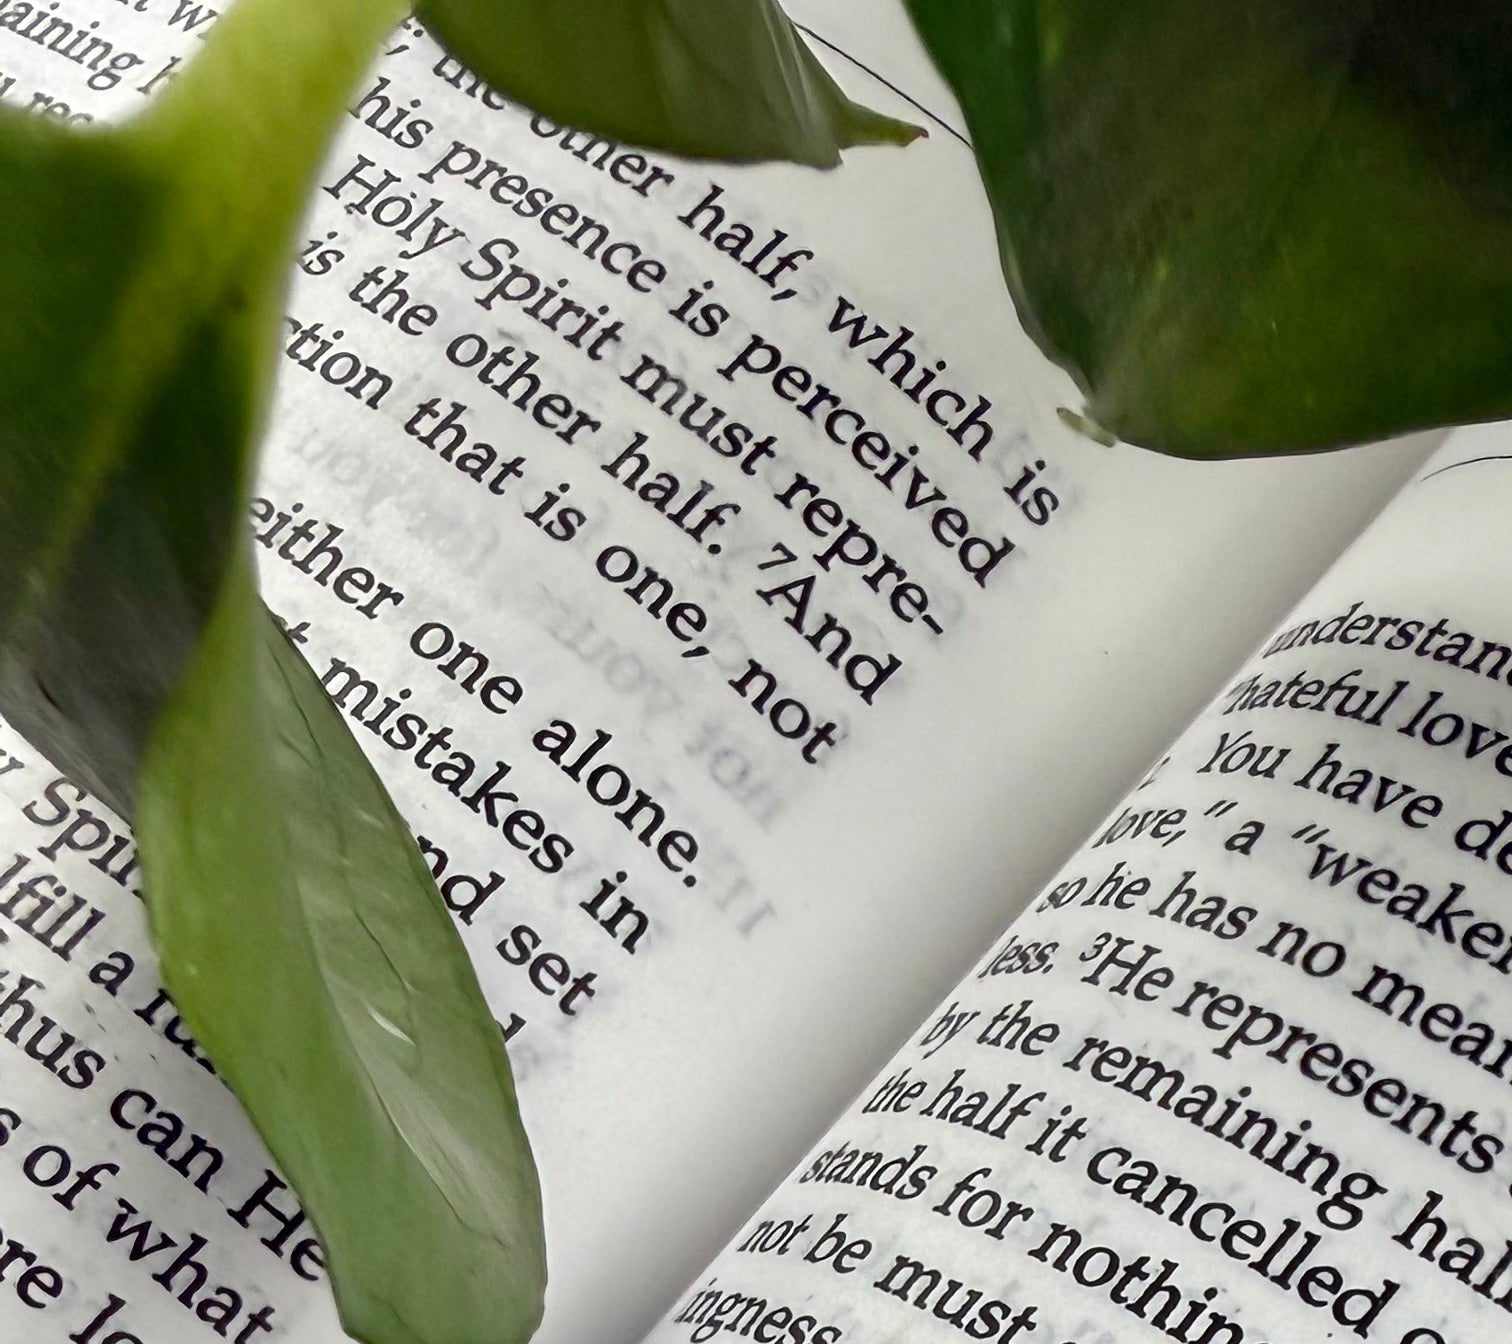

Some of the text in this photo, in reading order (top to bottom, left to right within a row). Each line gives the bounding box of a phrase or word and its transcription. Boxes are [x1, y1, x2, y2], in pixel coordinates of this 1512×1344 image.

[323, 155, 943, 635] Holy Spirit must repre-
[349, 266, 741, 554] the other half.
[418, 141, 1015, 588] presence is perceived
[678, 185, 1059, 525] half, which is
[404, 398, 836, 764] that is one, not
[322, 655, 648, 954] mistakes in
[410, 623, 698, 887] one alone.
[1197, 731, 1291, 778] You
[1294, 744, 1443, 828] have
[88, 952, 134, 997] a
[496, 925, 597, 1016] set
[1149, 871, 1258, 939] has
[1257, 922, 1346, 977] no
[110, 1089, 223, 1194] can
[1063, 1038, 1388, 1230] remaining
[1172, 982, 1504, 1173] represents
[23, 1145, 120, 1211] of
[803, 1214, 872, 1273] be
[920, 1069, 1046, 1139] half
[1087, 1147, 1400, 1339] cancelled
[932, 1168, 1034, 1240] for
